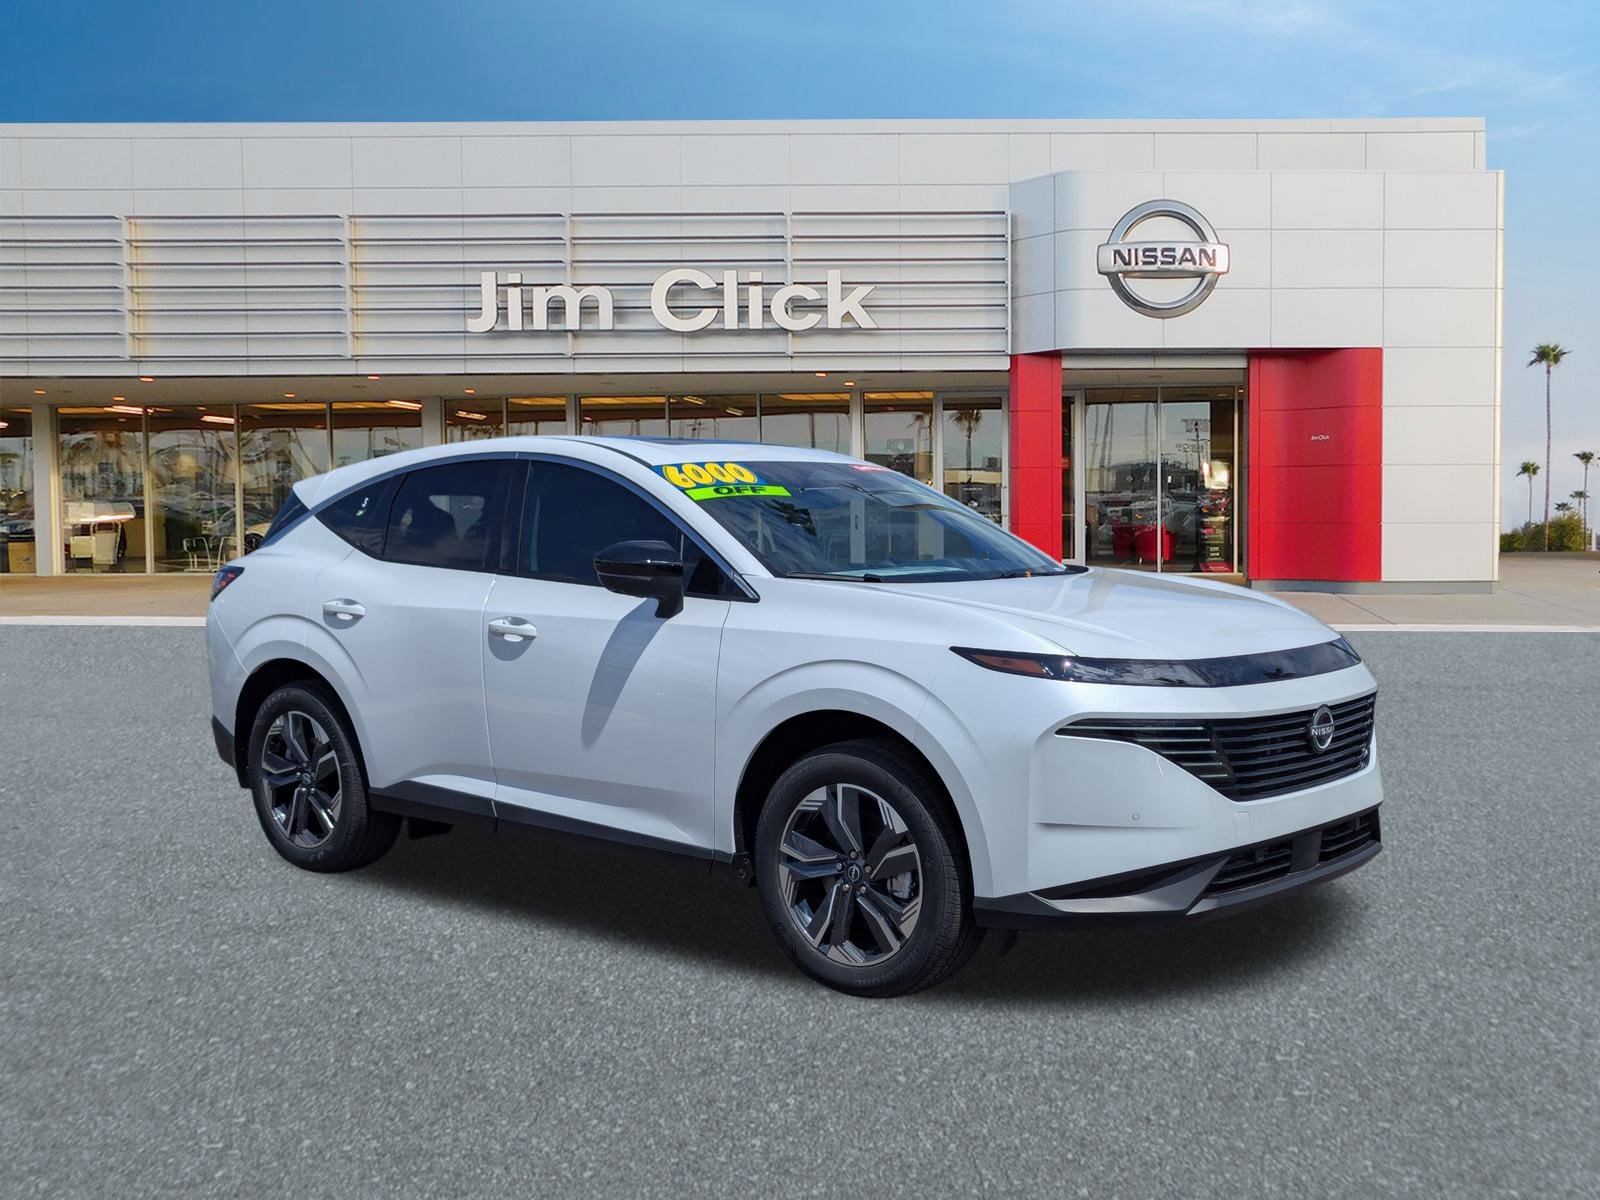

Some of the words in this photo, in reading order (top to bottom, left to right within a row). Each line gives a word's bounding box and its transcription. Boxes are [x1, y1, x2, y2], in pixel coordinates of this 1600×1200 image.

[1112, 247, 1217, 267] NISSAN
[467, 270, 614, 333] Jim
[650, 268, 879, 333] Click
[662, 462, 758, 489] 6000
[712, 485, 767, 496] OFF
